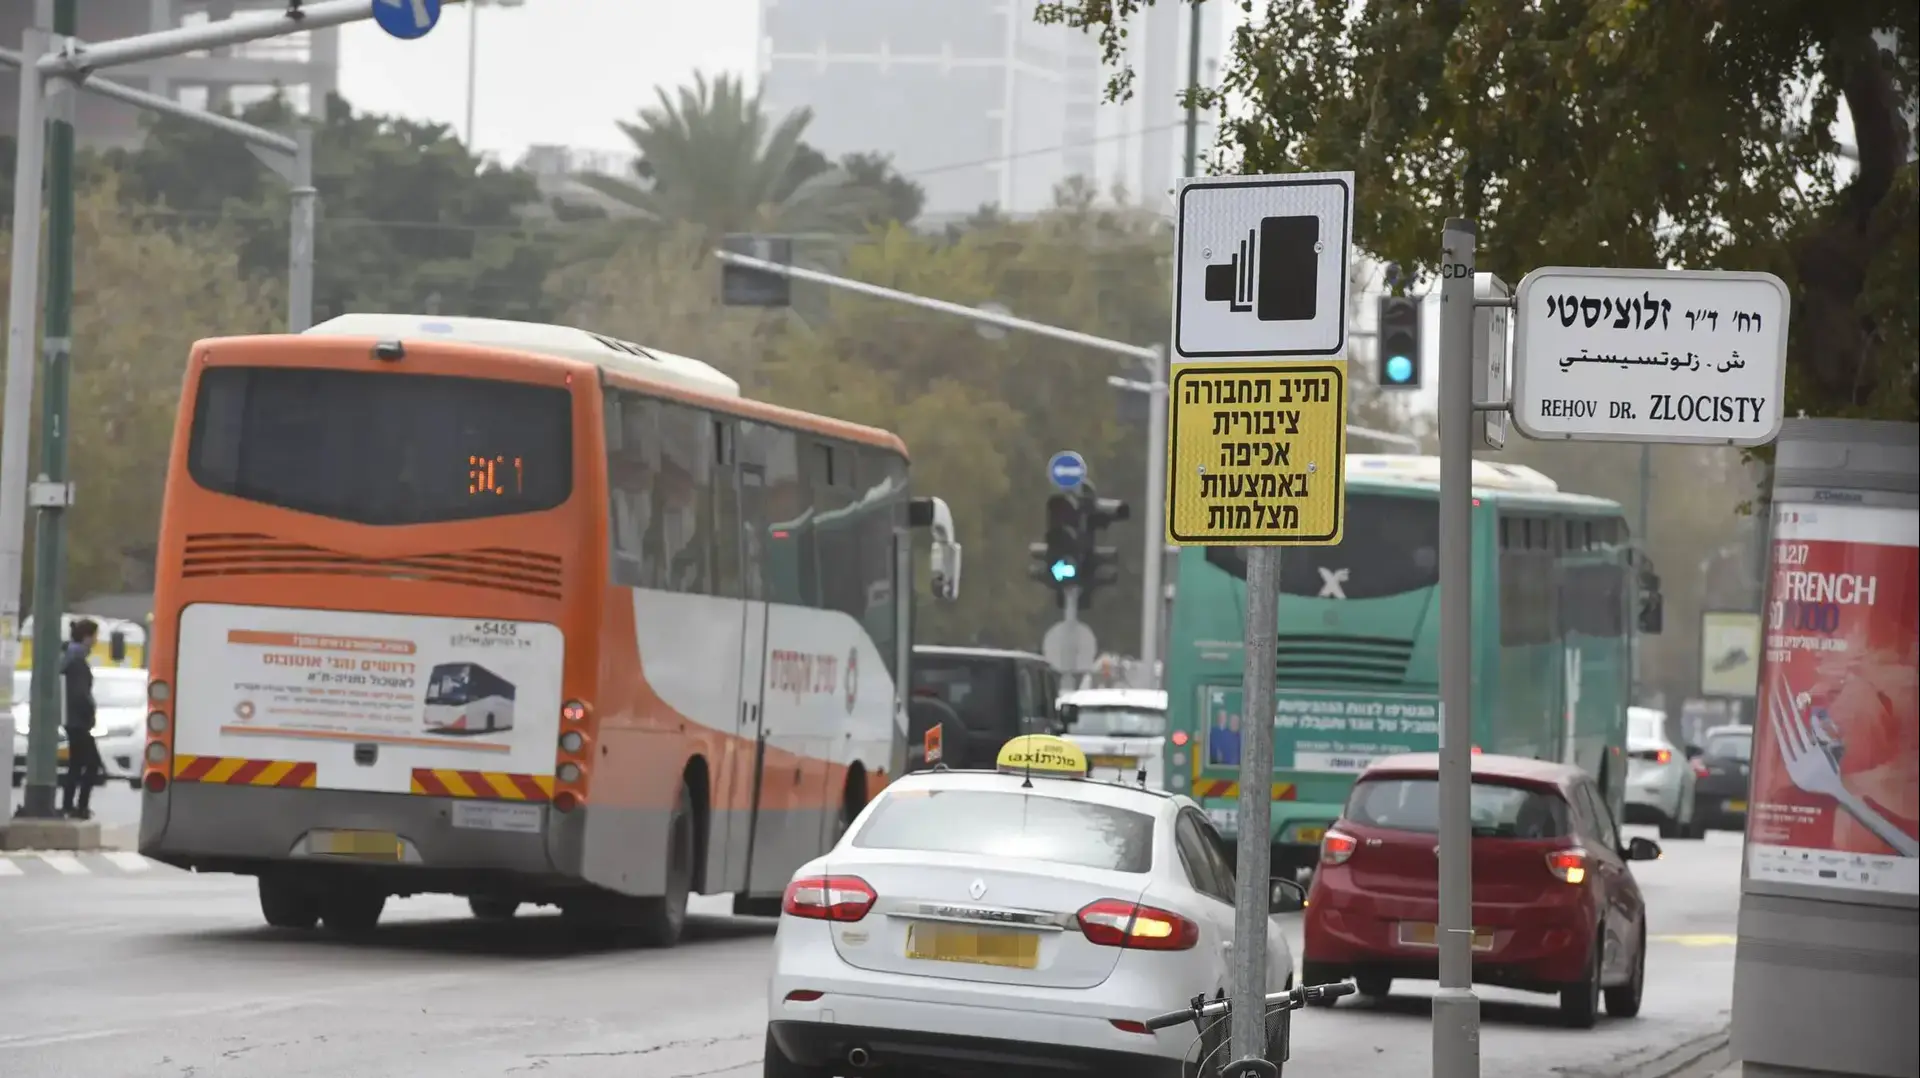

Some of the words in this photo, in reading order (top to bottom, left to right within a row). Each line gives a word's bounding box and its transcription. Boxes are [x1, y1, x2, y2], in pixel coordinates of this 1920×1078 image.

[1546, 291, 1672, 331] זלוציסטי
[1685, 309, 1718, 332] ד"ר
[1733, 310, 1762, 333] רח'
[1558, 348, 1700, 373] زلوتسيستي
[1185, 379, 1271, 404] תחבורה
[1279, 378, 1330, 402] נתיב
[1541, 399, 1597, 418] REHOV
[1609, 401, 1636, 419] DR.
[1649, 394, 1766, 423] ZLOCISTY
[1213, 410, 1300, 435] ציבורית
[1221, 442, 1290, 466] אכיפה
[1201, 473, 1308, 498] באמצעות
[1208, 500, 1299, 529] מצלמות
[1785, 571, 1877, 606] FRENCH
[263, 653, 322, 667] אוטובוס
[328, 656, 356, 670] נהגי
[361, 659, 416, 674] דרושים
